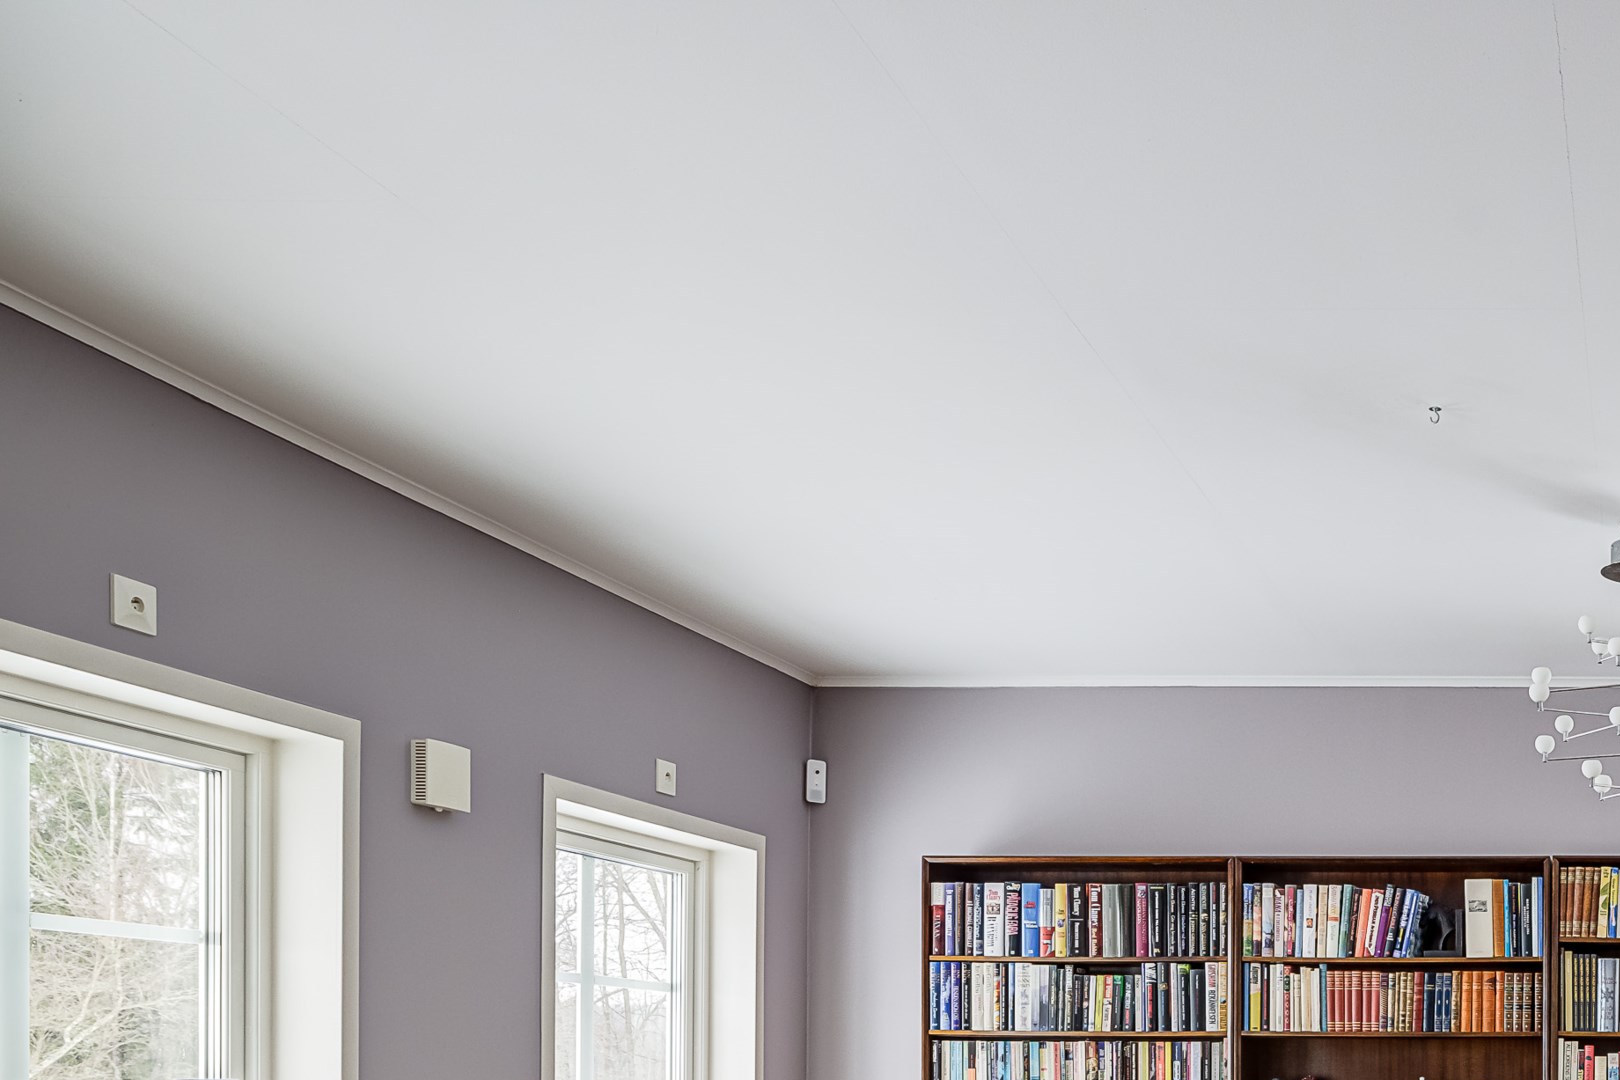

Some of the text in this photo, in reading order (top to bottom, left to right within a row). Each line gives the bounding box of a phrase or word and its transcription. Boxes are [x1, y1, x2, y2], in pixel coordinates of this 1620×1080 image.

[1091, 886, 1100, 902] Tom
[1072, 899, 1080, 916] Clancy
[1091, 903, 1100, 927] Clancy
